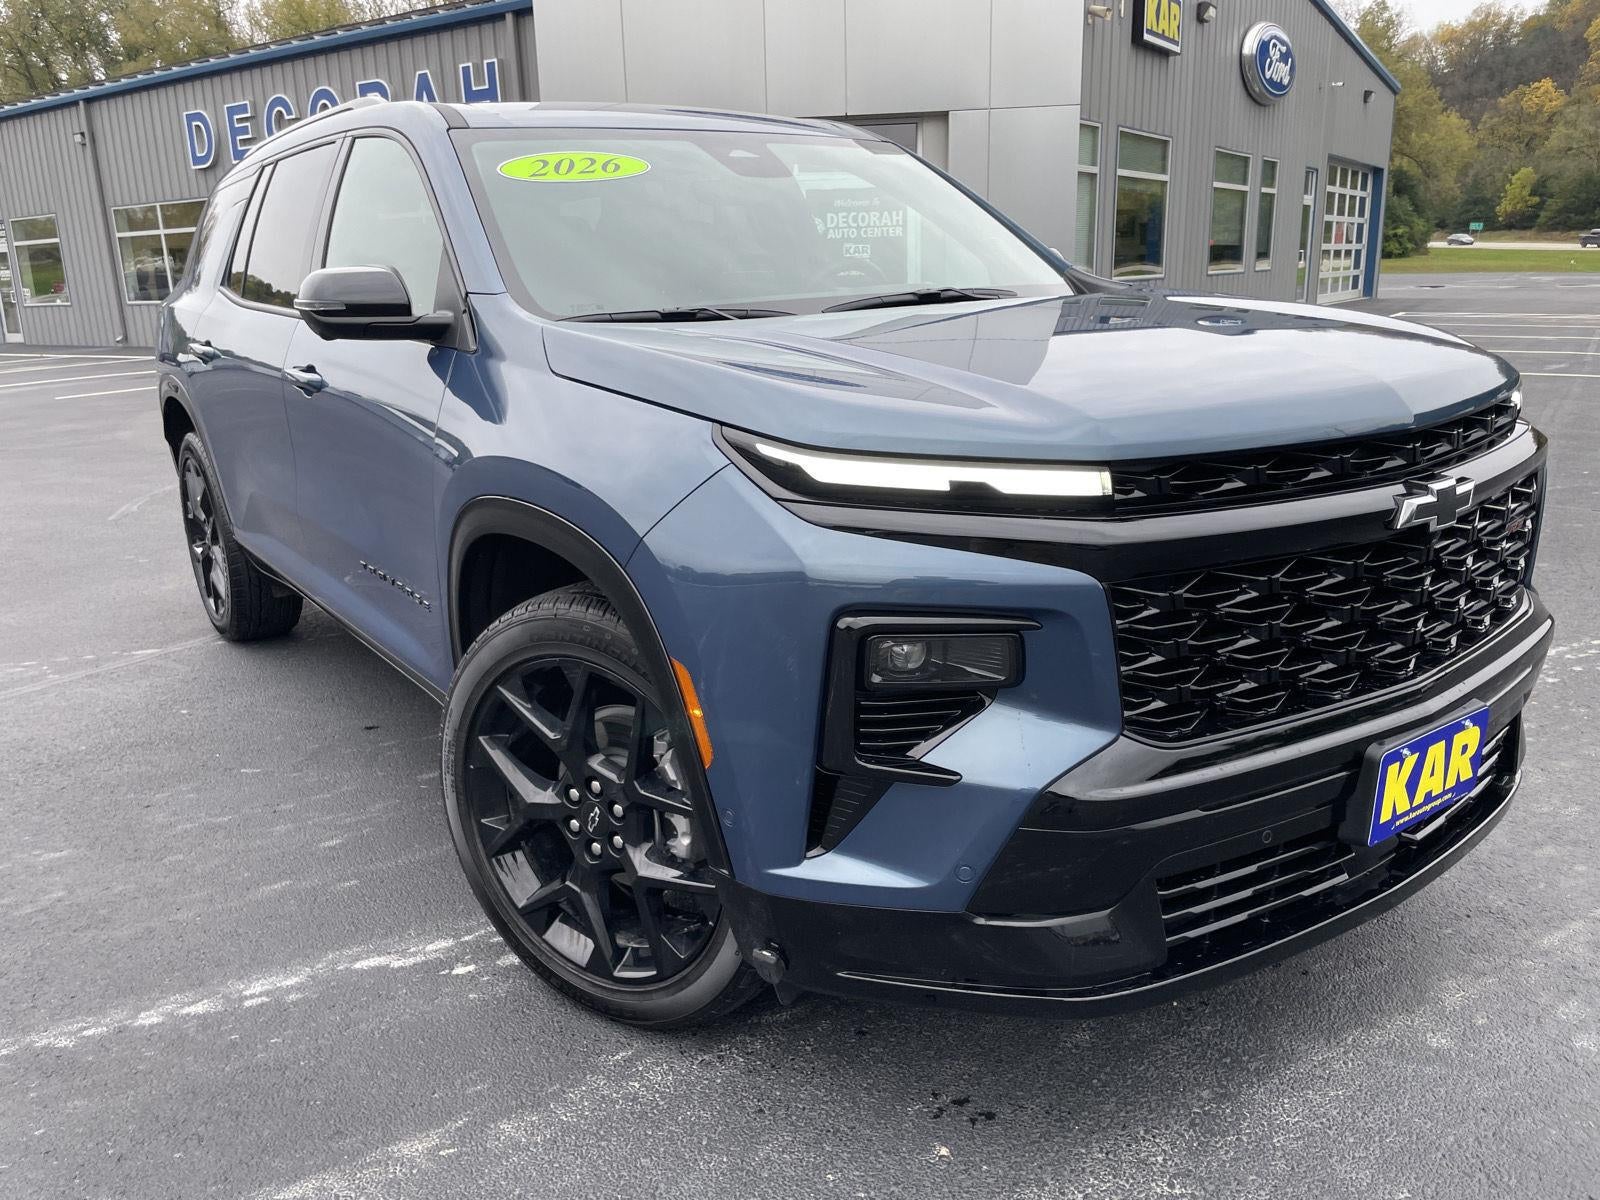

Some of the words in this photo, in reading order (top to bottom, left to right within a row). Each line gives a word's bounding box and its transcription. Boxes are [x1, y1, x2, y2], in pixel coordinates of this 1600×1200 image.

[1146, 0, 1180, 41] KAR
[1264, 39, 1292, 86] Ford
[529, 157, 621, 178] 2026
[827, 210, 903, 228] DECORAH
[827, 228, 858, 239] AUTO
[861, 226, 903, 238] CENTER
[844, 245, 870, 257] KAR
[1379, 726, 1481, 825] KAR
